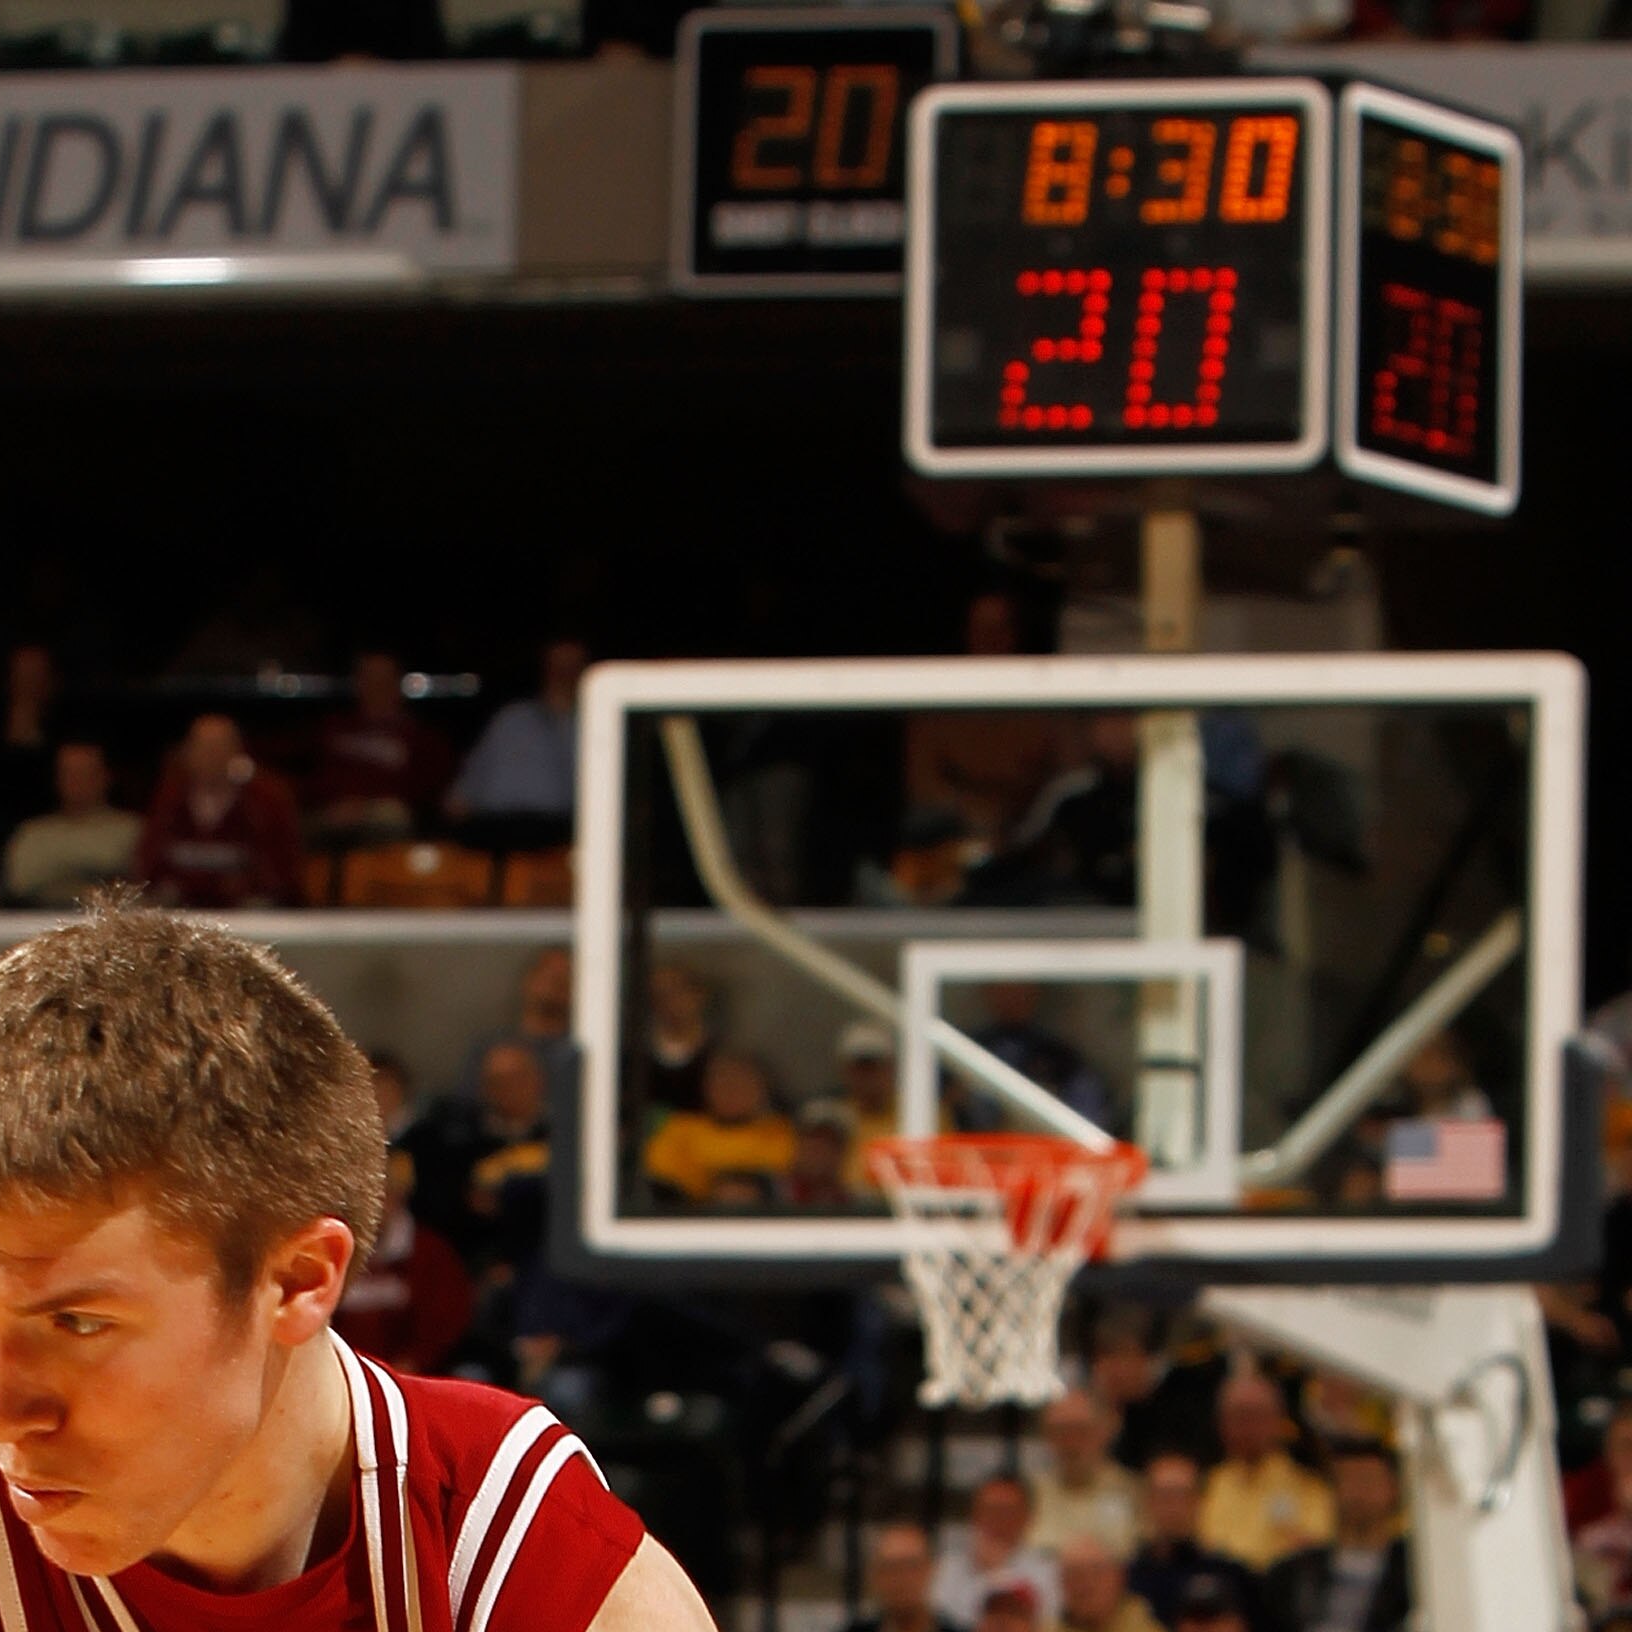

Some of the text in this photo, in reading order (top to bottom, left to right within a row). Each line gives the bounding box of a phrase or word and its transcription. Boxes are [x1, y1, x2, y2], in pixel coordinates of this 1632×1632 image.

[730, 65, 901, 190] 20
[1022, 116, 1299, 225] 8:30
[999, 267, 1238, 429] 20
